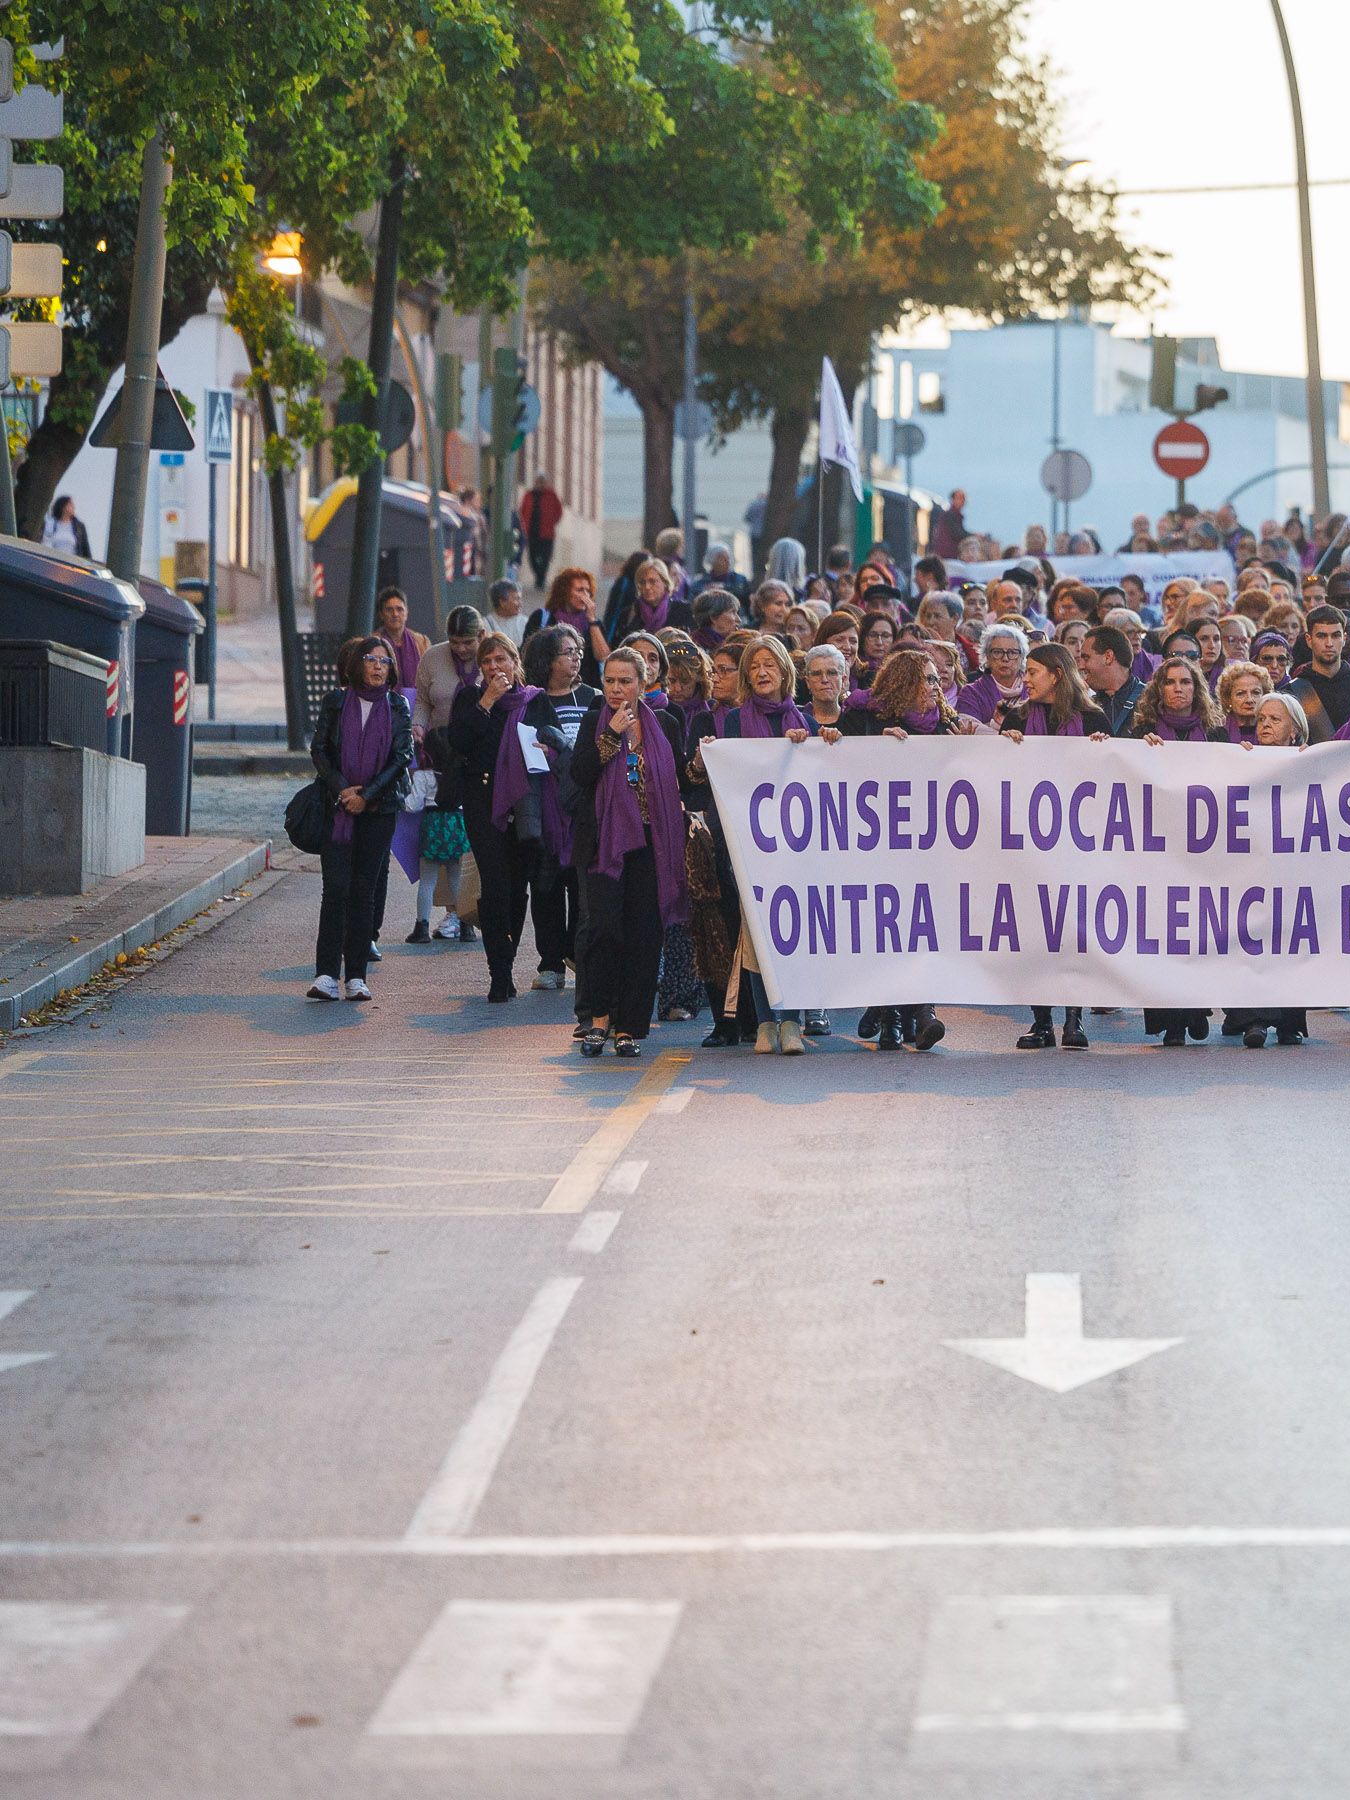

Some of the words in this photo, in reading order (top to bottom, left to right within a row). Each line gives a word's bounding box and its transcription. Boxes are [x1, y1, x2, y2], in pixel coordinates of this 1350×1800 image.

[749, 779, 979, 853] CONSEJO
[1001, 780, 1165, 852] LOCAL
[1187, 785, 1250, 853] DE
[753, 883, 938, 956] ONTRA
[959, 883, 1020, 953] LA
[1038, 884, 1320, 956] VIOLENCIA
